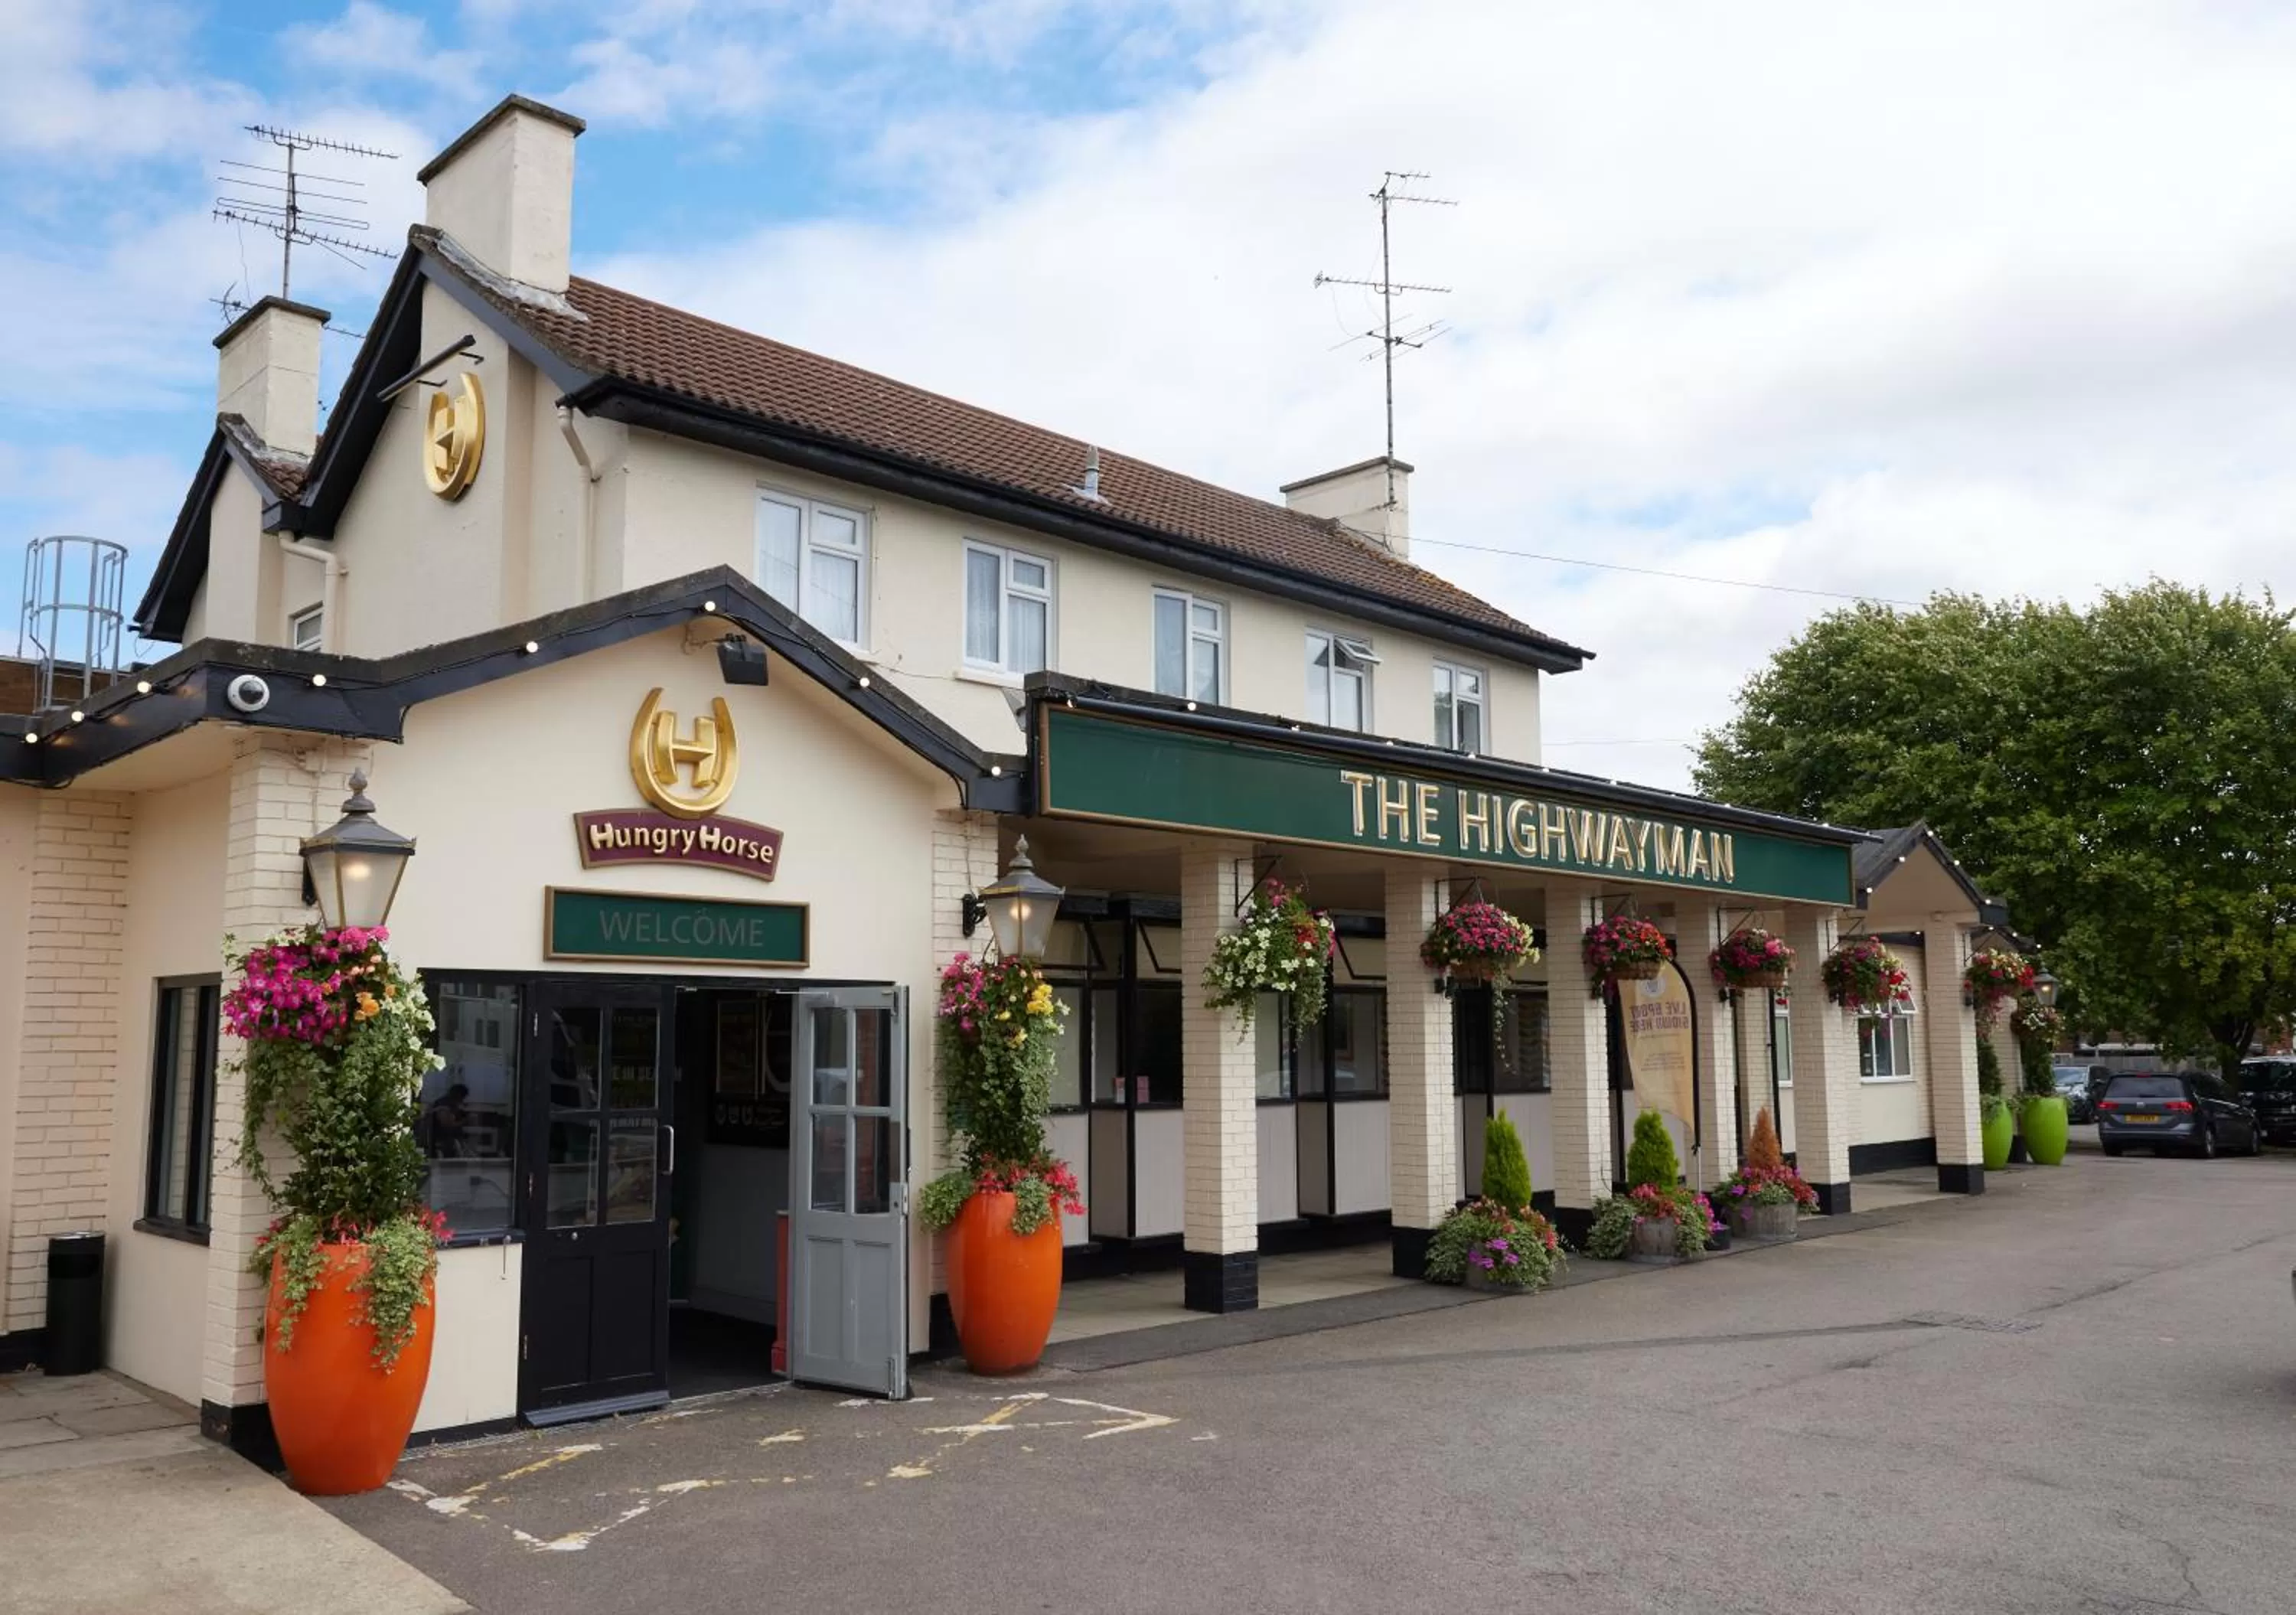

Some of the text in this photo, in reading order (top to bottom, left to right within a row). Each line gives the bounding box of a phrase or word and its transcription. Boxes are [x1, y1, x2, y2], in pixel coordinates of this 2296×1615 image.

[1340, 770, 1735, 883] THE HIGHWAYMAN
[600, 910, 764, 947] WELCOME
